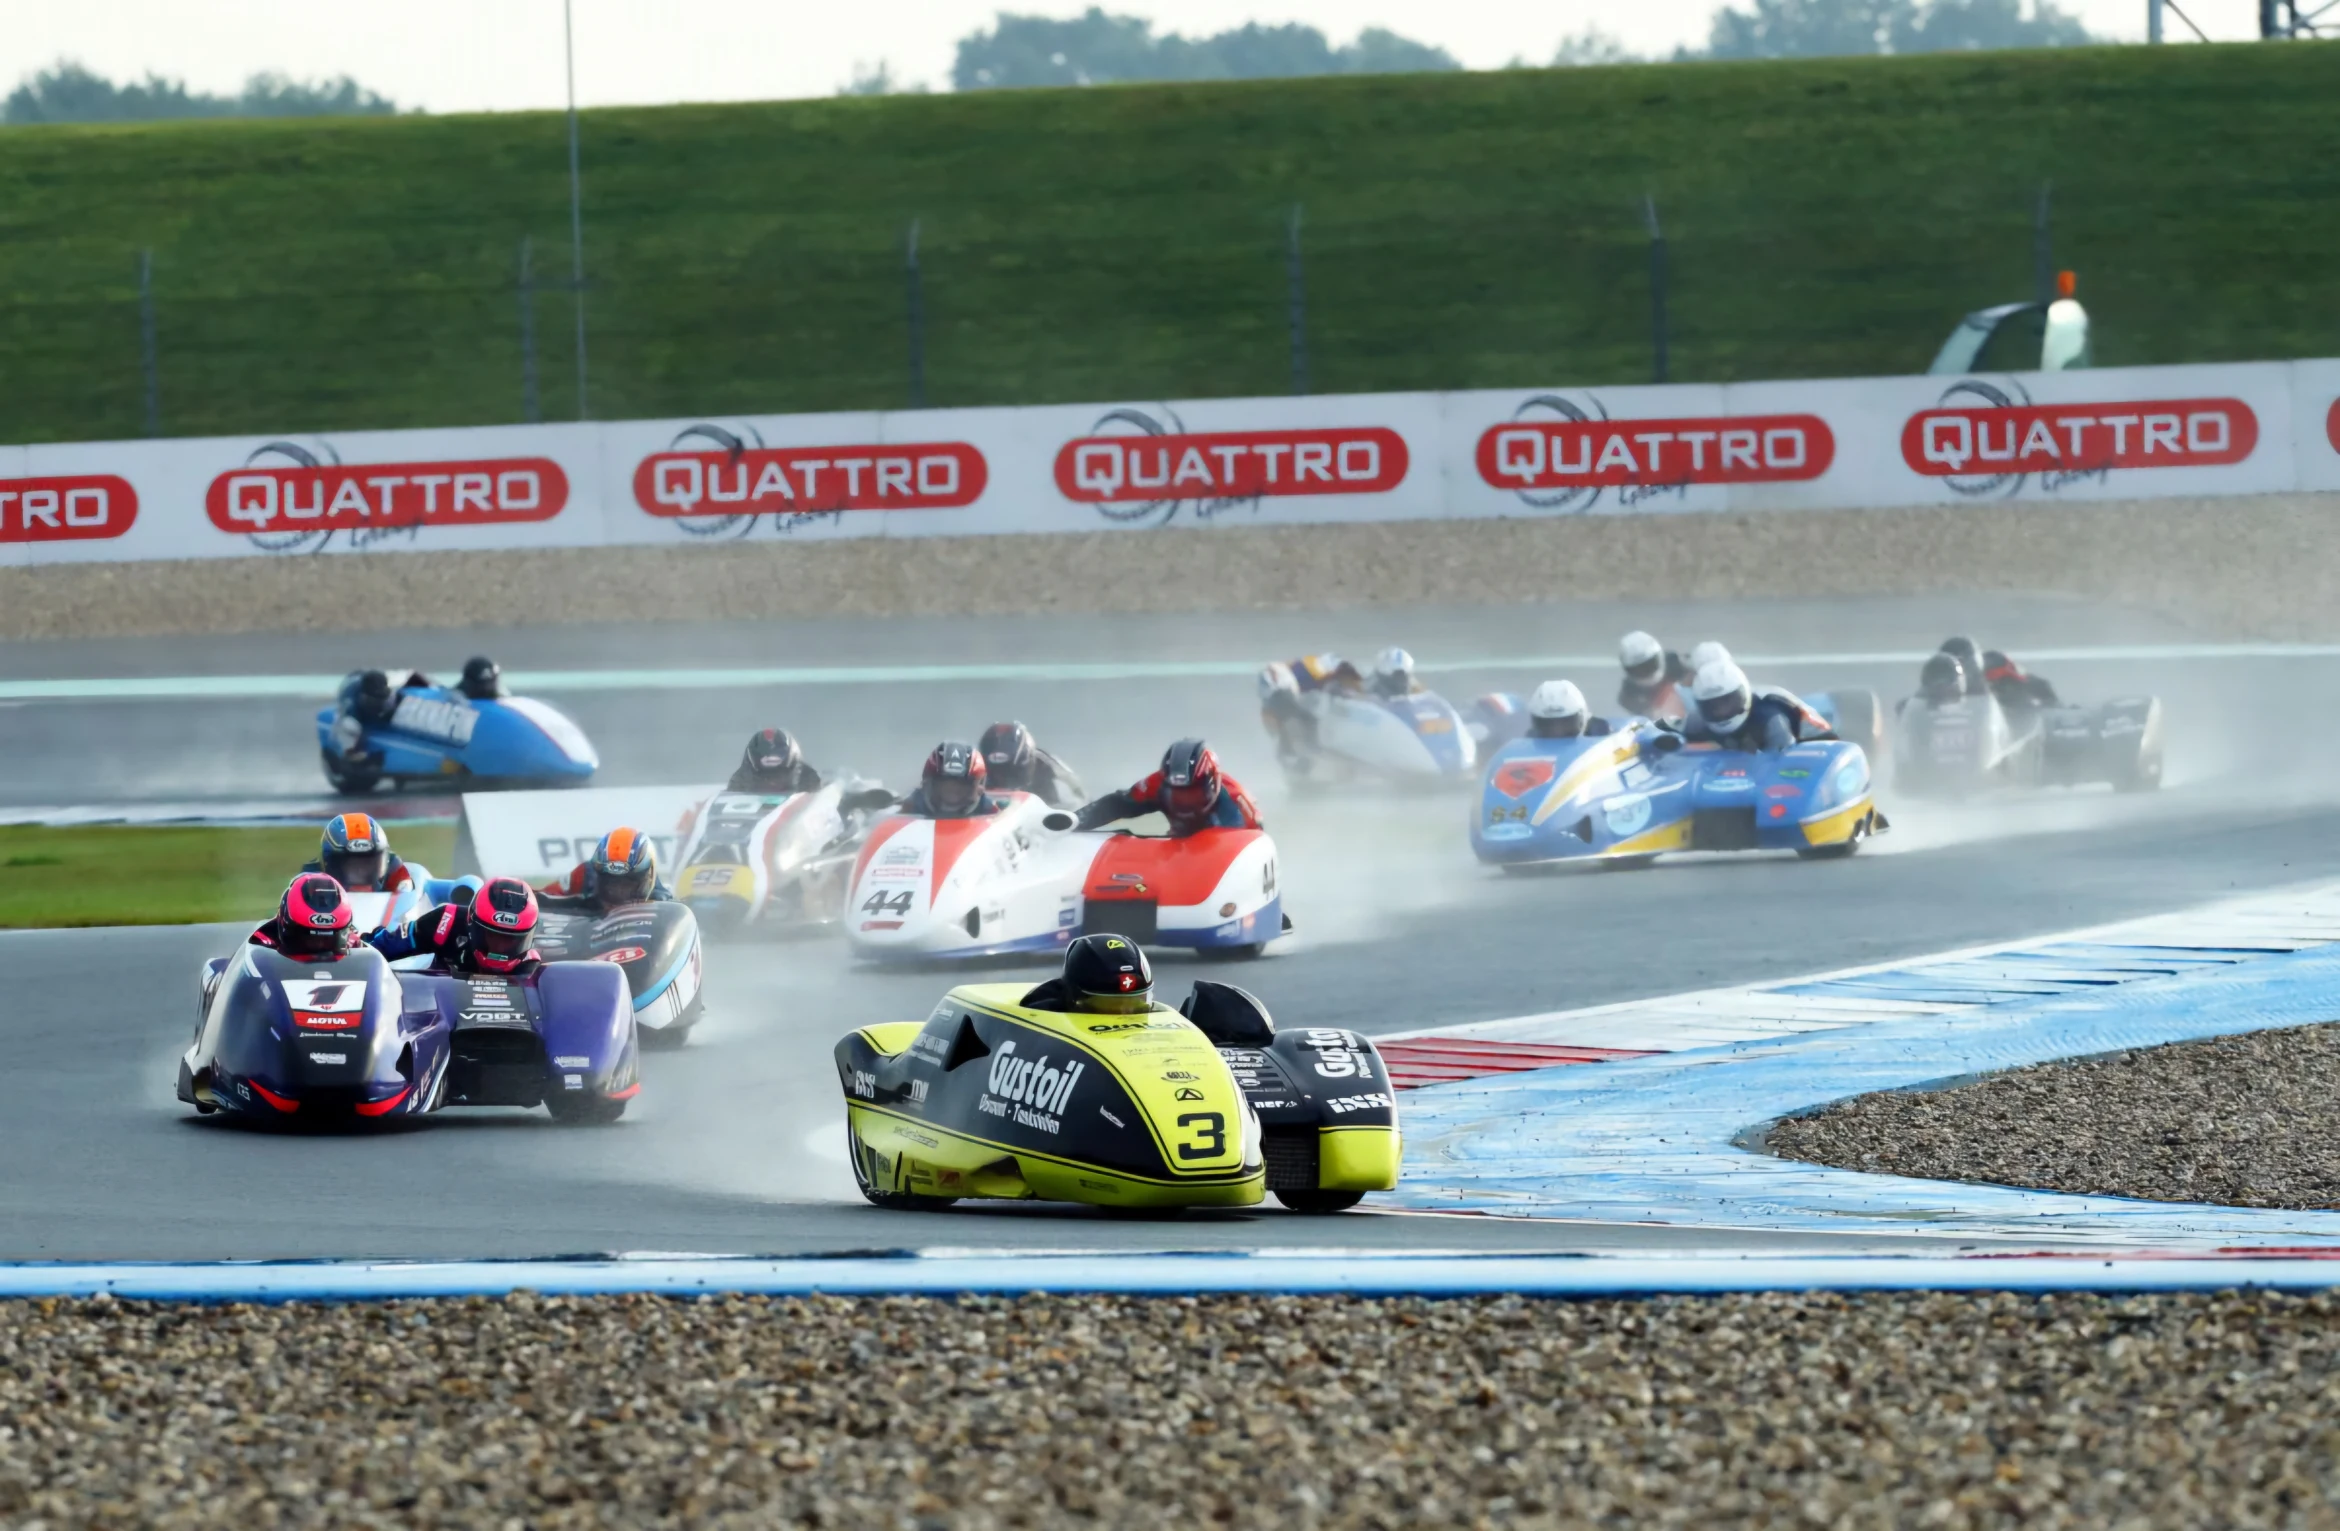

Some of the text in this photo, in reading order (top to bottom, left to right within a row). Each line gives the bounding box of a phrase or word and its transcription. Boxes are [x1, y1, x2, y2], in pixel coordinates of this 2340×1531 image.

[1495, 428, 1806, 483] QUATTRO
[1922, 411, 2230, 470] QUATTRO
[653, 455, 960, 512] QUATTRO
[1074, 440, 1381, 498] QUATTRO
[228, 470, 540, 528] QUATTRO
[861, 889, 915, 917] 44
[306, 1017, 348, 1025] MOTUL
[307, 984, 350, 1007] 1
[988, 1040, 1085, 1116] Gustoil
[1177, 1112, 1226, 1160] 3
